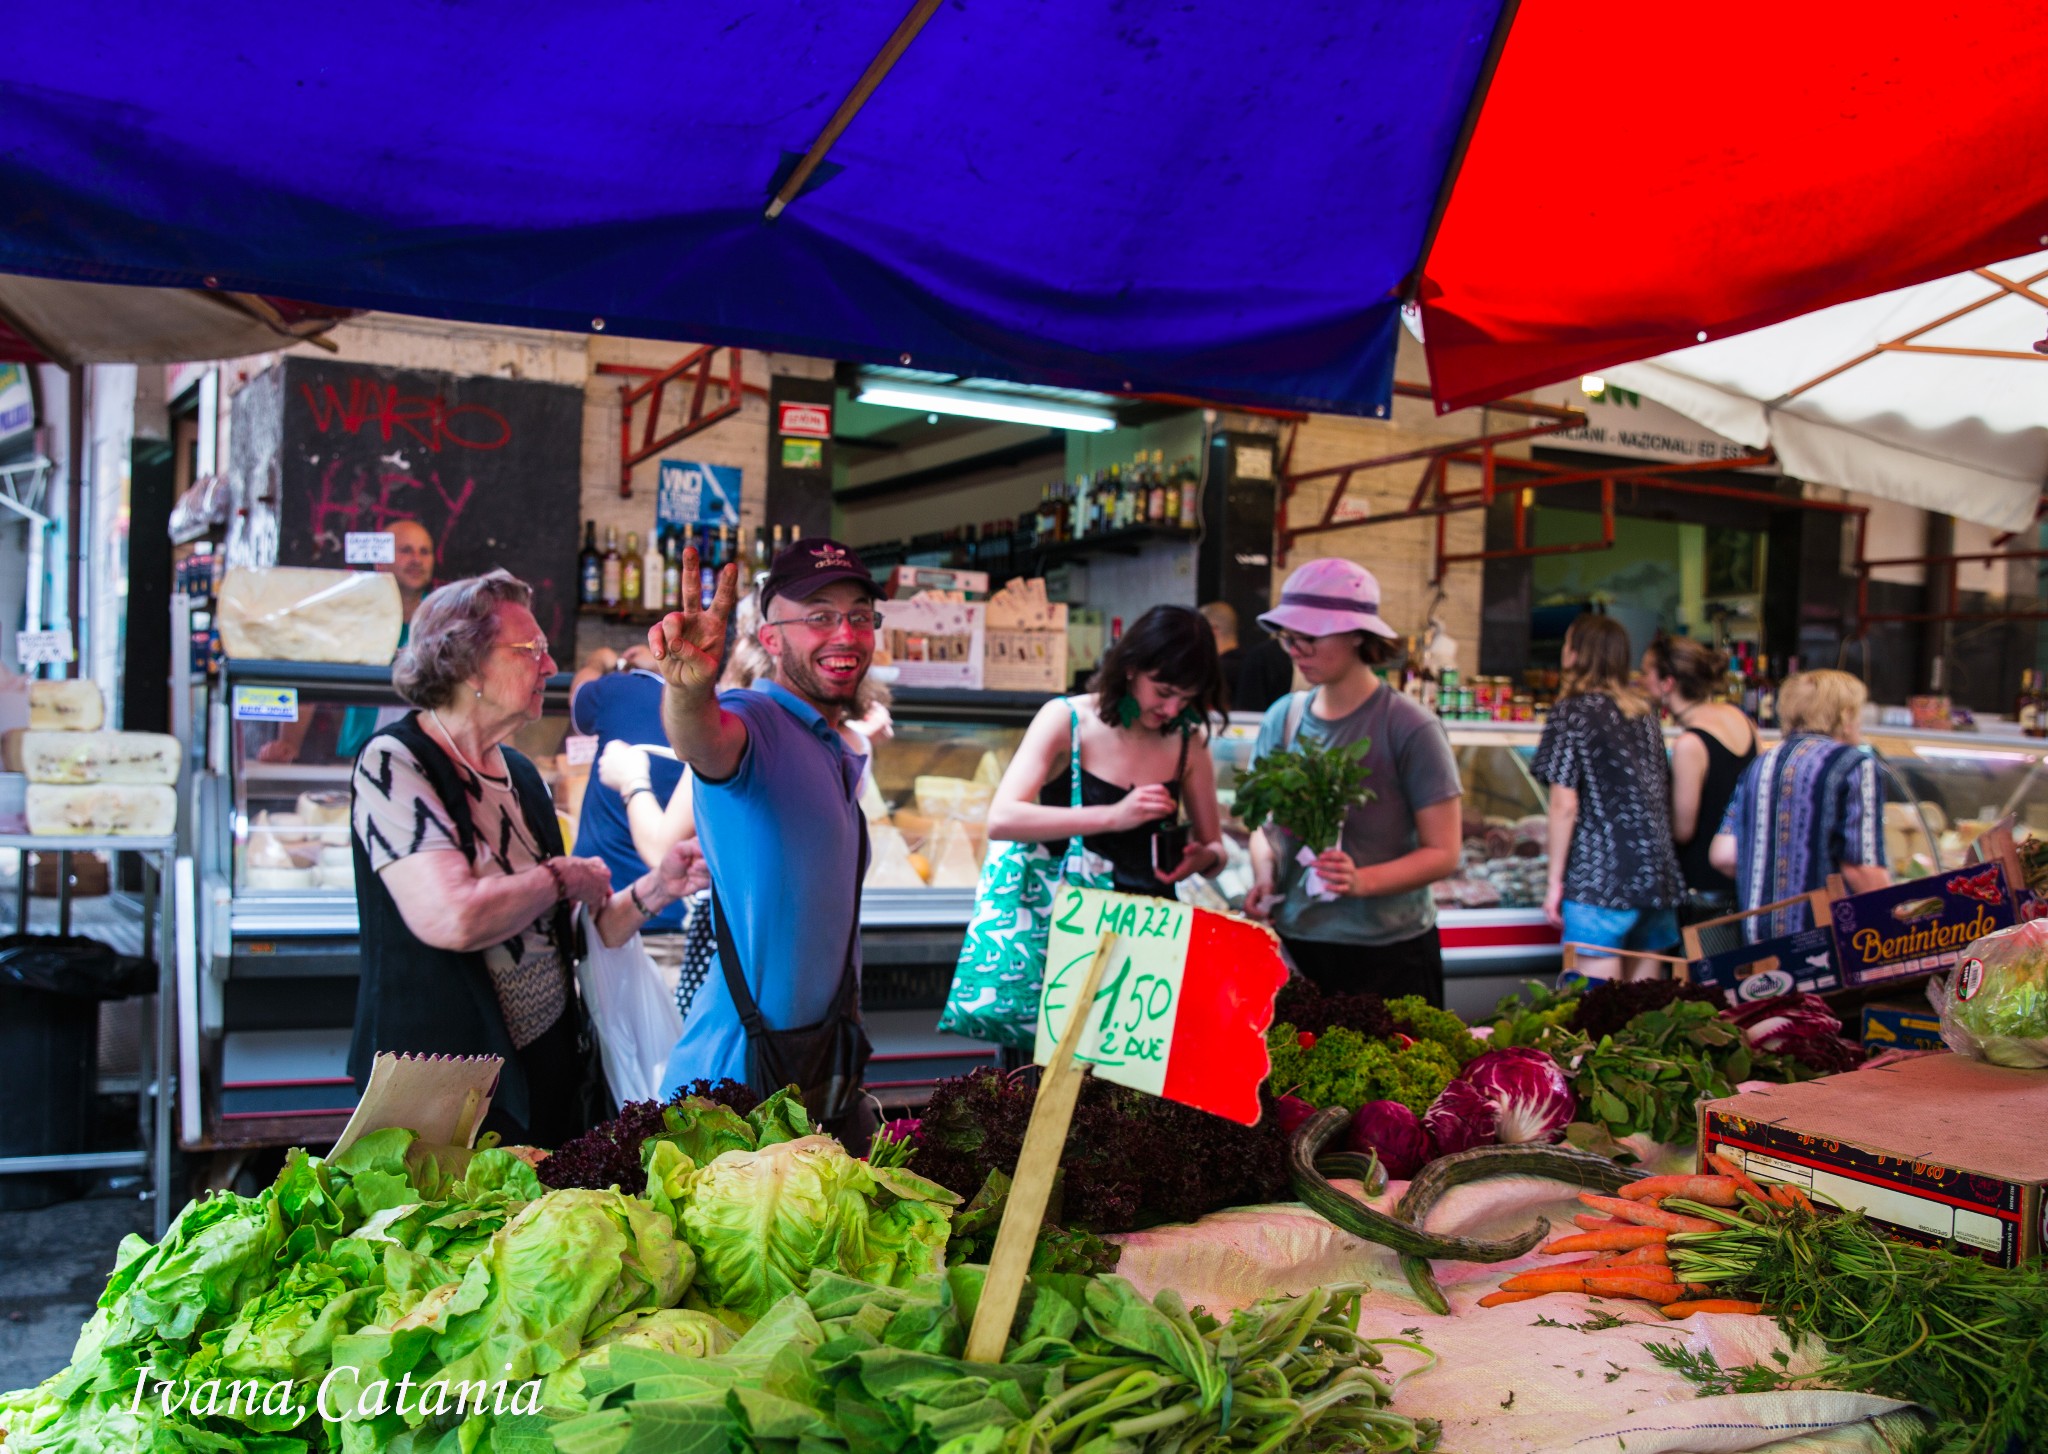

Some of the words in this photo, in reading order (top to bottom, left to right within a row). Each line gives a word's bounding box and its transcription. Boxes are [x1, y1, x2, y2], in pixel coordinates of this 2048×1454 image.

[814, 557, 853, 569] adidas
[1056, 889, 1084, 935] 2
[1095, 900, 1183, 940] MAZZI
[1852, 903, 1996, 963] Benintende
[1123, 1036, 1164, 1061] DUE
[1918, 1224, 1948, 1236] SPEDITORE
